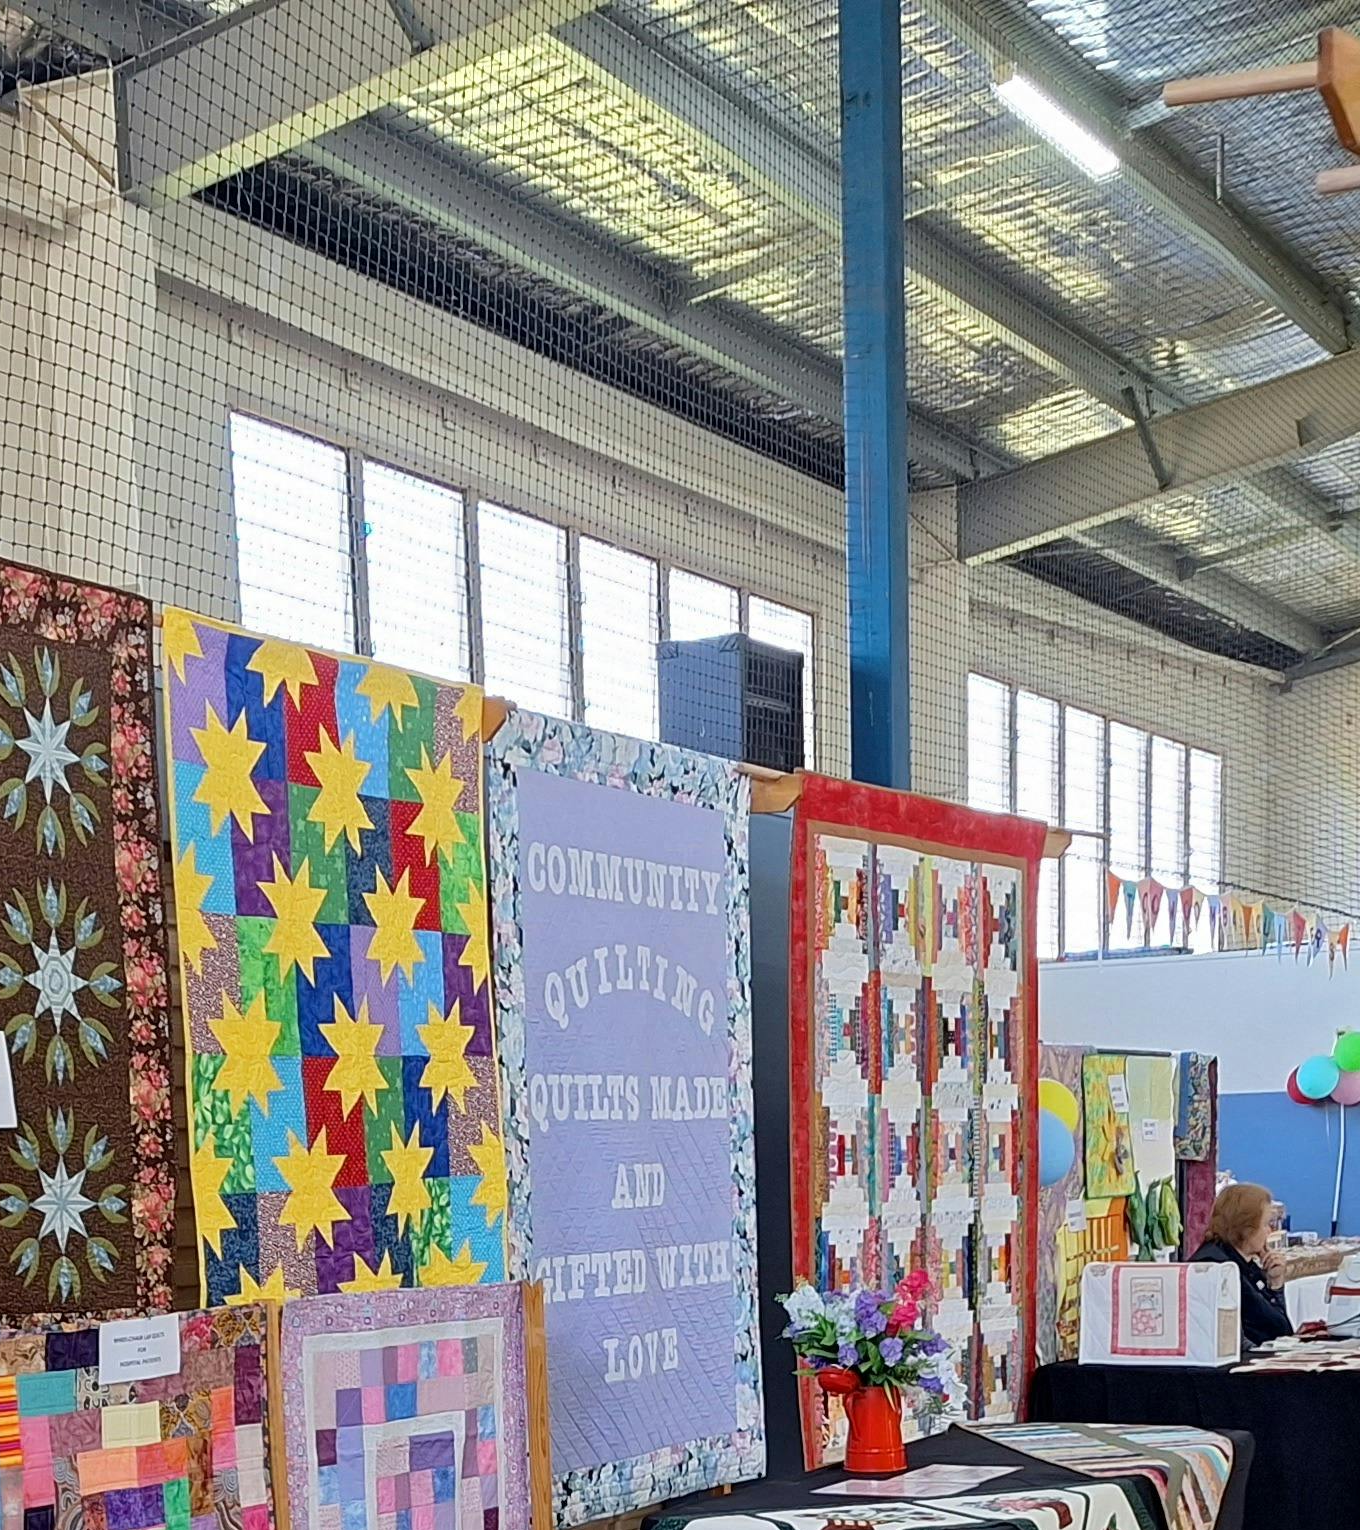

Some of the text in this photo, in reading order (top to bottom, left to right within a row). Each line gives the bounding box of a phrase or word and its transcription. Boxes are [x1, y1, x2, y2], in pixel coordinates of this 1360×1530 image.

[528, 842, 721, 915] COMMUNITY
[545, 944, 715, 1036] QUILTING
[530, 1073, 727, 1132] QUILTS MADE
[611, 1163, 665, 1208] AND
[535, 1241, 732, 1304] GIFTED WITH
[603, 1328, 678, 1383] LOVE
